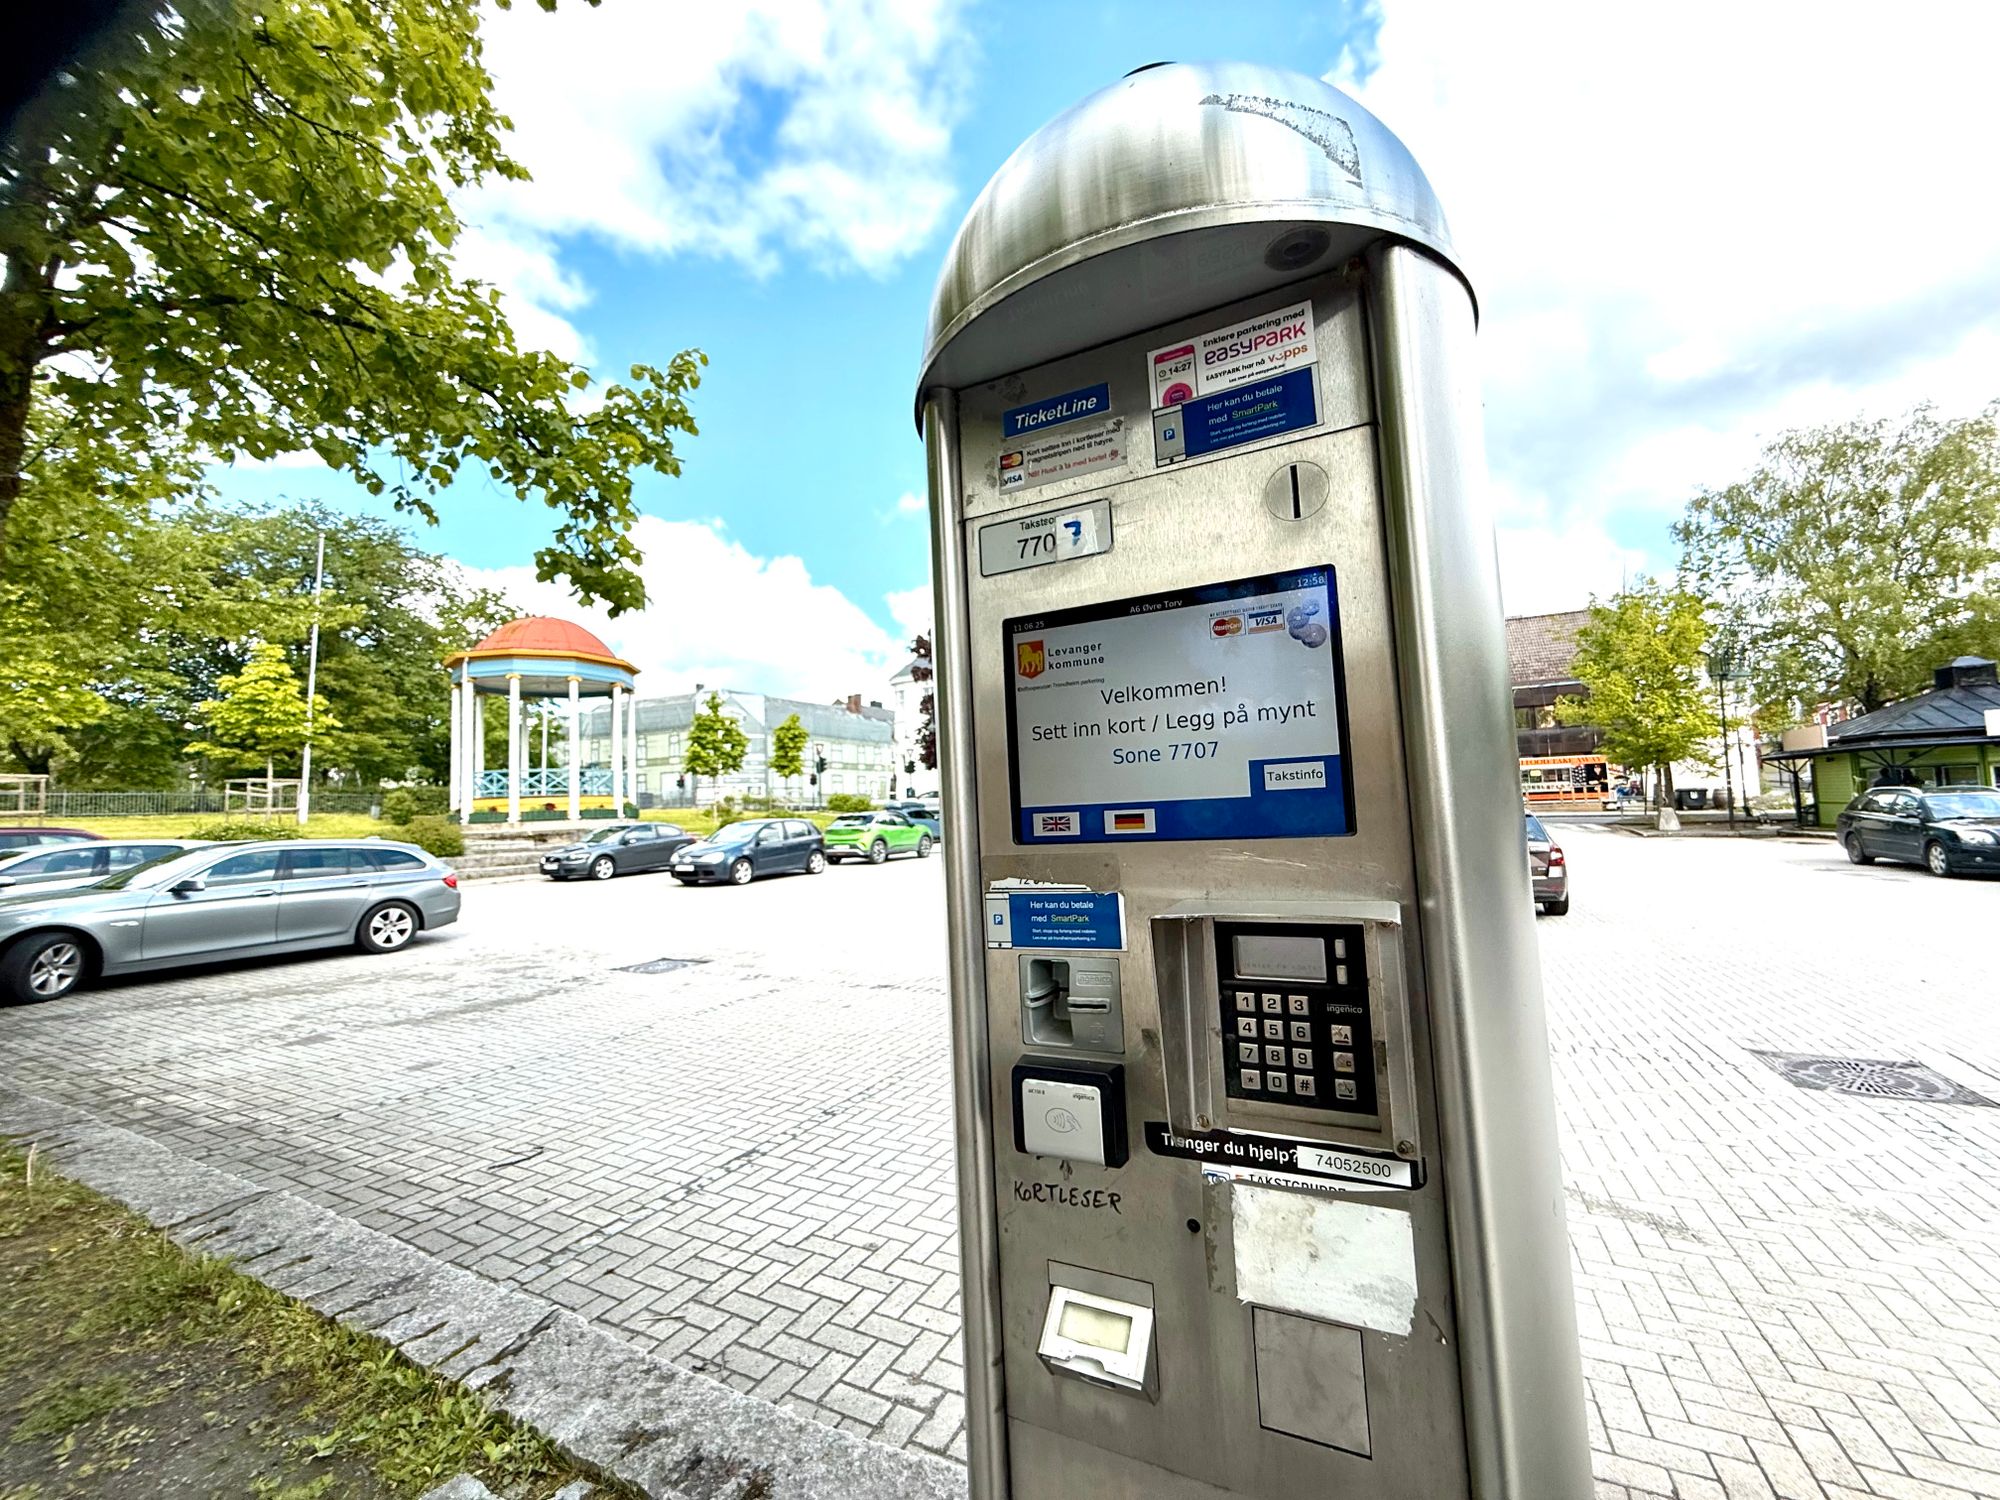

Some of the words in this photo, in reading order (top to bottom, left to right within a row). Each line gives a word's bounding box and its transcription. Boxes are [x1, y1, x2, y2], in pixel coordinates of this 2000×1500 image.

[1203, 333, 1235, 348] Enklere
[1236, 318, 1281, 342] parkering
[1283, 308, 1305, 323] med
[1169, 362, 1192, 375] 14:27
[1206, 366, 1241, 381] EASYPARK
[1242, 362, 1254, 371] har
[1207, 402, 1222, 412] Her
[1224, 397, 1240, 408] kan
[1242, 393, 1254, 402] du
[1256, 385, 1283, 399] betale
[1015, 397, 1097, 429] TicketLine
[1208, 415, 1228, 426] med
[1232, 400, 1278, 419] SmartPark
[1003, 474, 1022, 485] VISA
[1020, 516, 1056, 531] Takstso
[1130, 605, 1140, 614] A6
[1142, 602, 1162, 612] Øvre
[1164, 600, 1184, 608] Torv
[1296, 575, 1326, 588] 12:58
[1255, 616, 1278, 626] VISA
[1048, 642, 1102, 657] Levanger
[1048, 656, 1105, 670] kommune
[1101, 676, 1227, 705] Velkommen!
[1032, 722, 1068, 742] Sett
[1073, 720, 1101, 738] inn
[1108, 715, 1146, 735] kort
[1166, 711, 1215, 732] Legg
[1223, 703, 1249, 729] på
[1257, 700, 1317, 724] mynt
[1112, 746, 1161, 765] Sone
[1168, 741, 1219, 760] 7707
[1266, 768, 1324, 782] Takstinfo
[1030, 900, 1044, 909] Her
[1044, 900, 1058, 909] kan
[1060, 901, 1070, 909] du
[1070, 901, 1094, 909] betale
[1031, 914, 1048, 922] med
[1050, 914, 1090, 923] SmartPark
[1242, 996, 1250, 1007] 1
[1267, 998, 1276, 1010] 2
[1294, 1000, 1304, 1011] 3
[1326, 1004, 1362, 1014] ingenico
[1242, 1022, 1252, 1033] 4
[1269, 1024, 1278, 1036] 5
[1296, 1027, 1305, 1038] 6
[1244, 1048, 1254, 1058] 7
[1271, 1050, 1280, 1062] 8
[1298, 1052, 1308, 1064] 9
[1224, 1142, 1244, 1156] du
[1249, 1144, 1298, 1165] hjelp?
[1315, 1154, 1392, 1178] 74052500
[1014, 1180, 1122, 1215] KORTLESER
